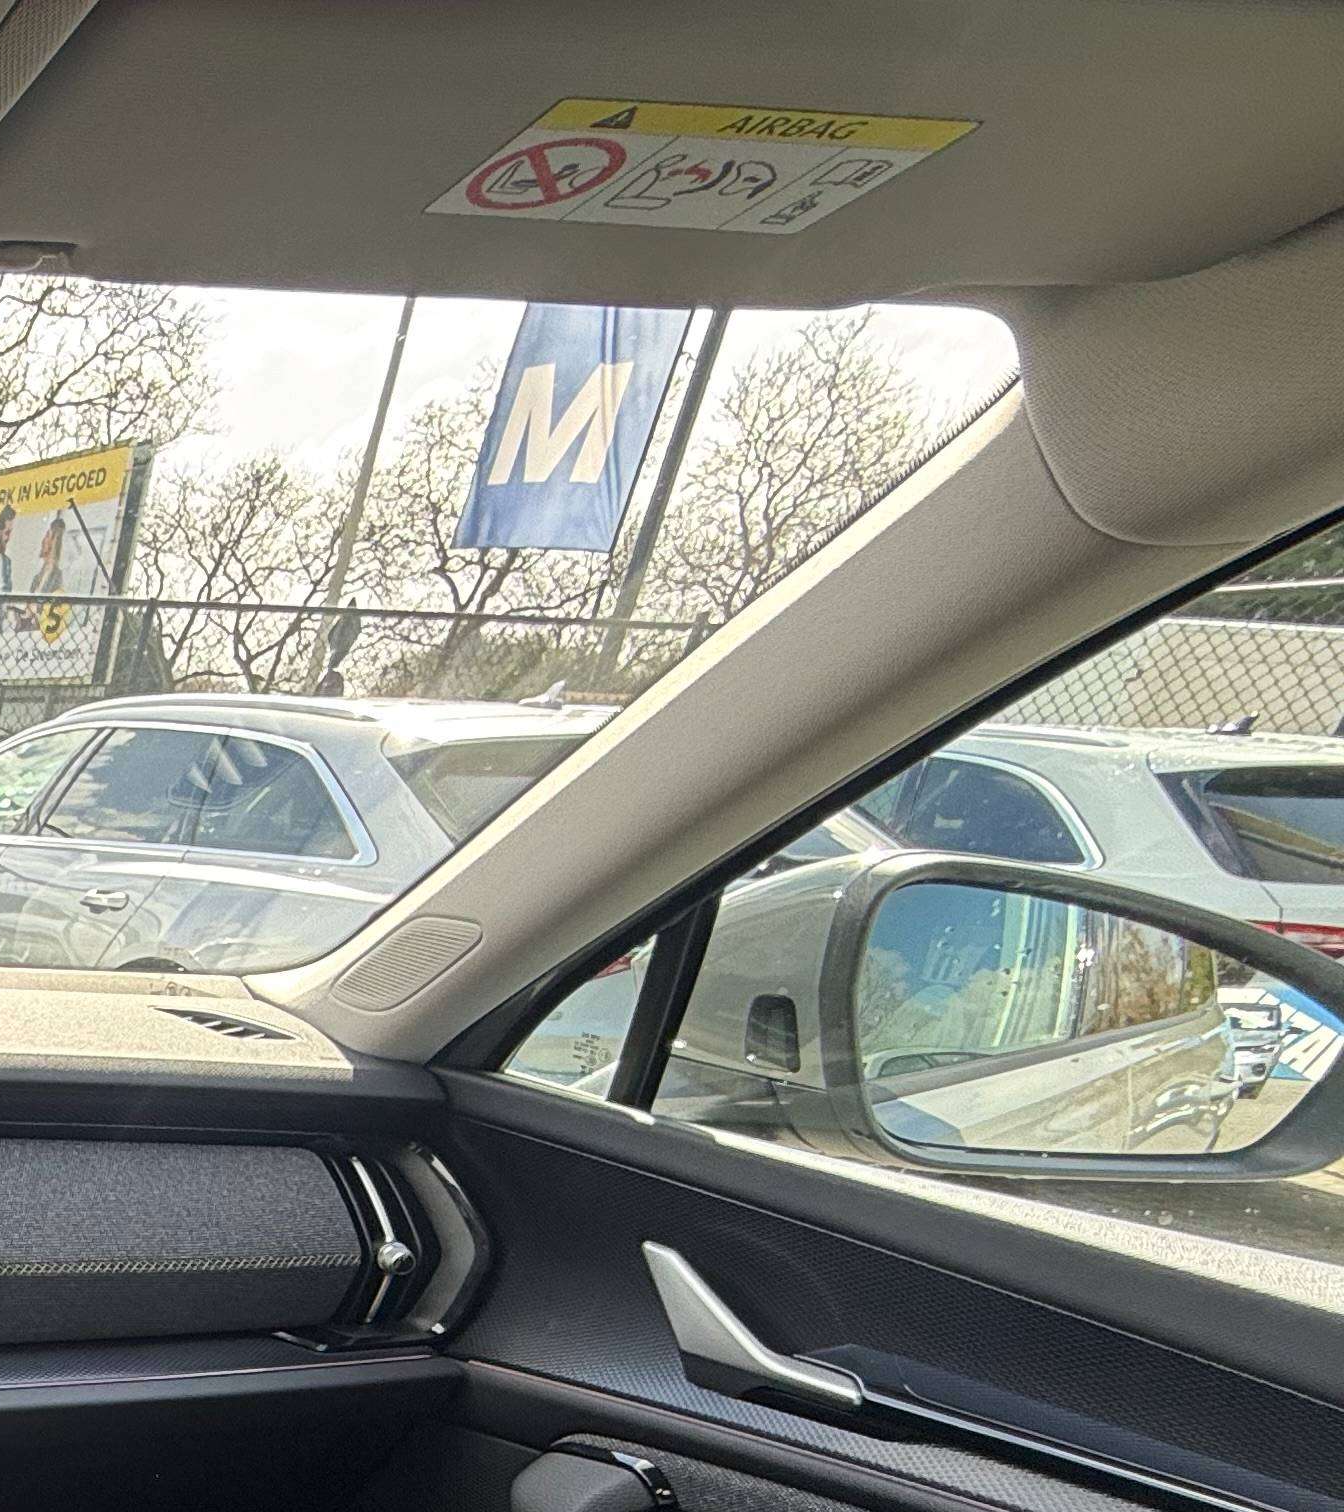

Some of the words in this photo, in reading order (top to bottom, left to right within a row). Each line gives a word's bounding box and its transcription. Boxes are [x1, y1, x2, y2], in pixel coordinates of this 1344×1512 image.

[718, 114, 869, 141] AIRBAG
[487, 360, 635, 487] M
[17, 482, 32, 503] IN
[34, 467, 108, 499] VASTGOED
